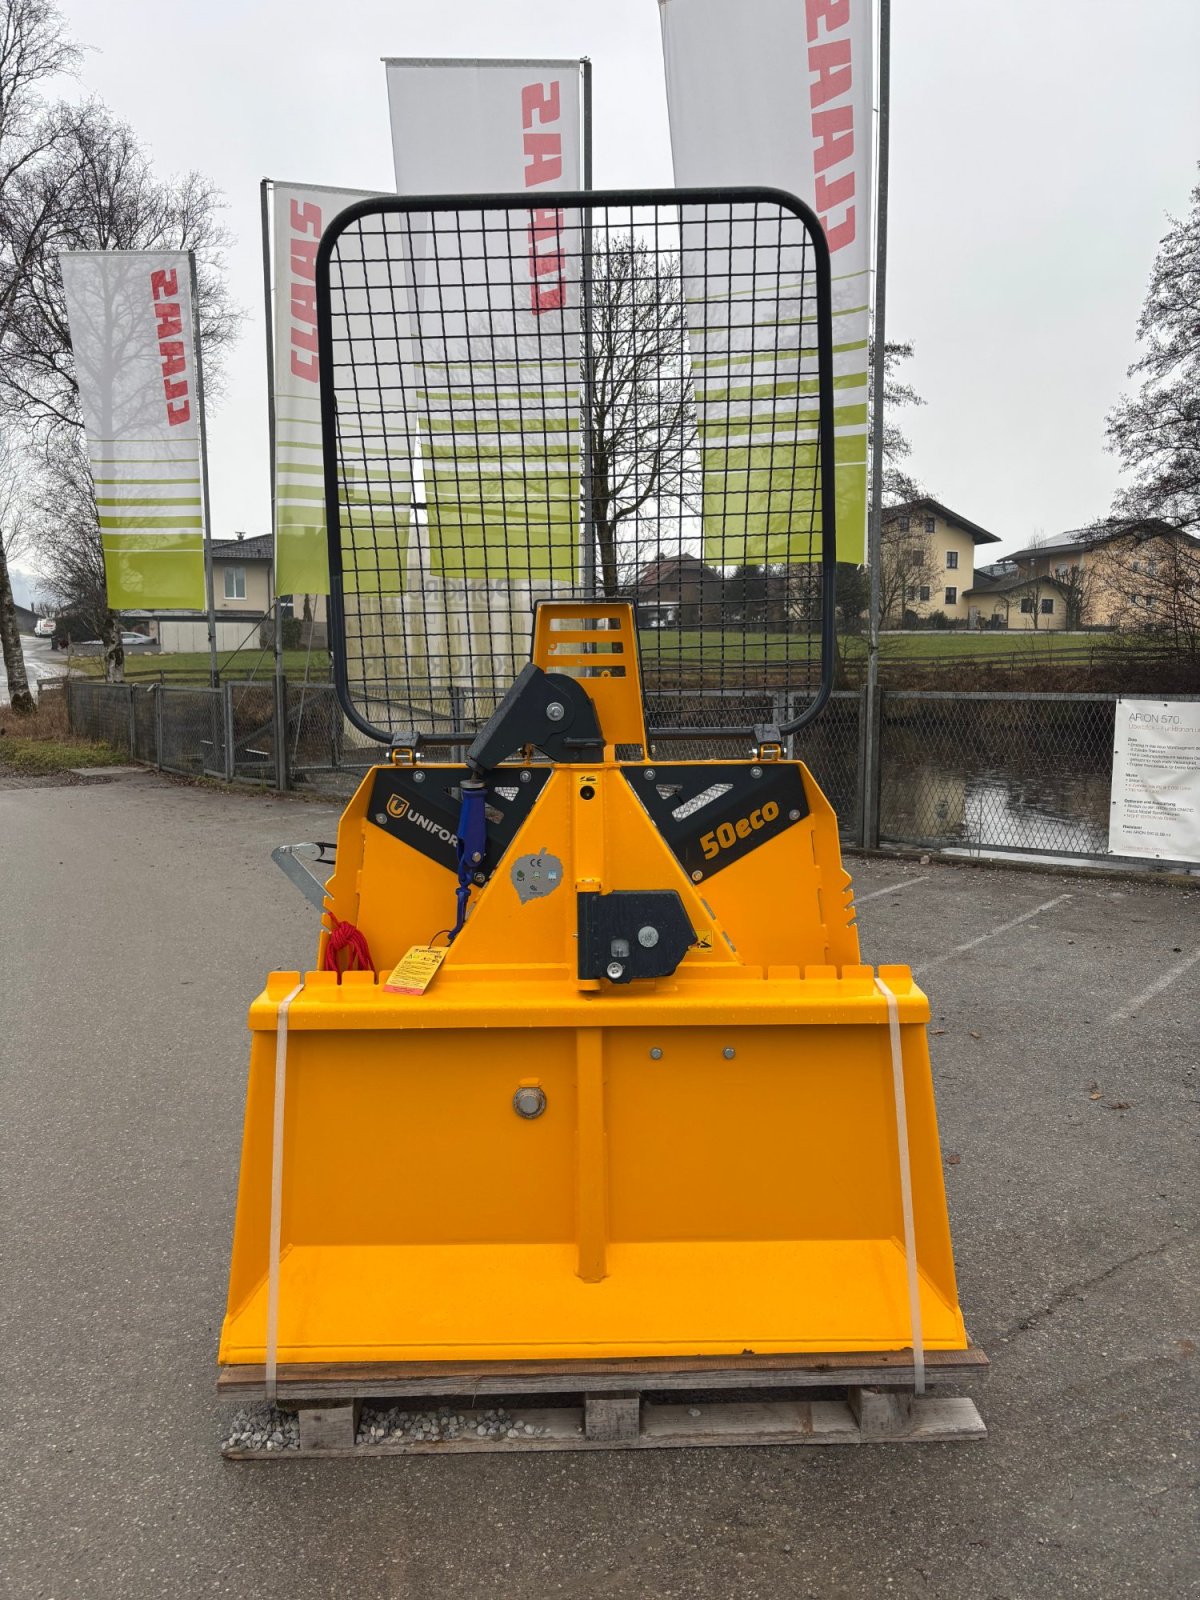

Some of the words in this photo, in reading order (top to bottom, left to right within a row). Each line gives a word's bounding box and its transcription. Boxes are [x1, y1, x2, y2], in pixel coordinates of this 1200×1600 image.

[290, 198, 322, 384] CLAAS
[407, 808, 459, 848] UNIFOR
[699, 801, 780, 860] 50eco
